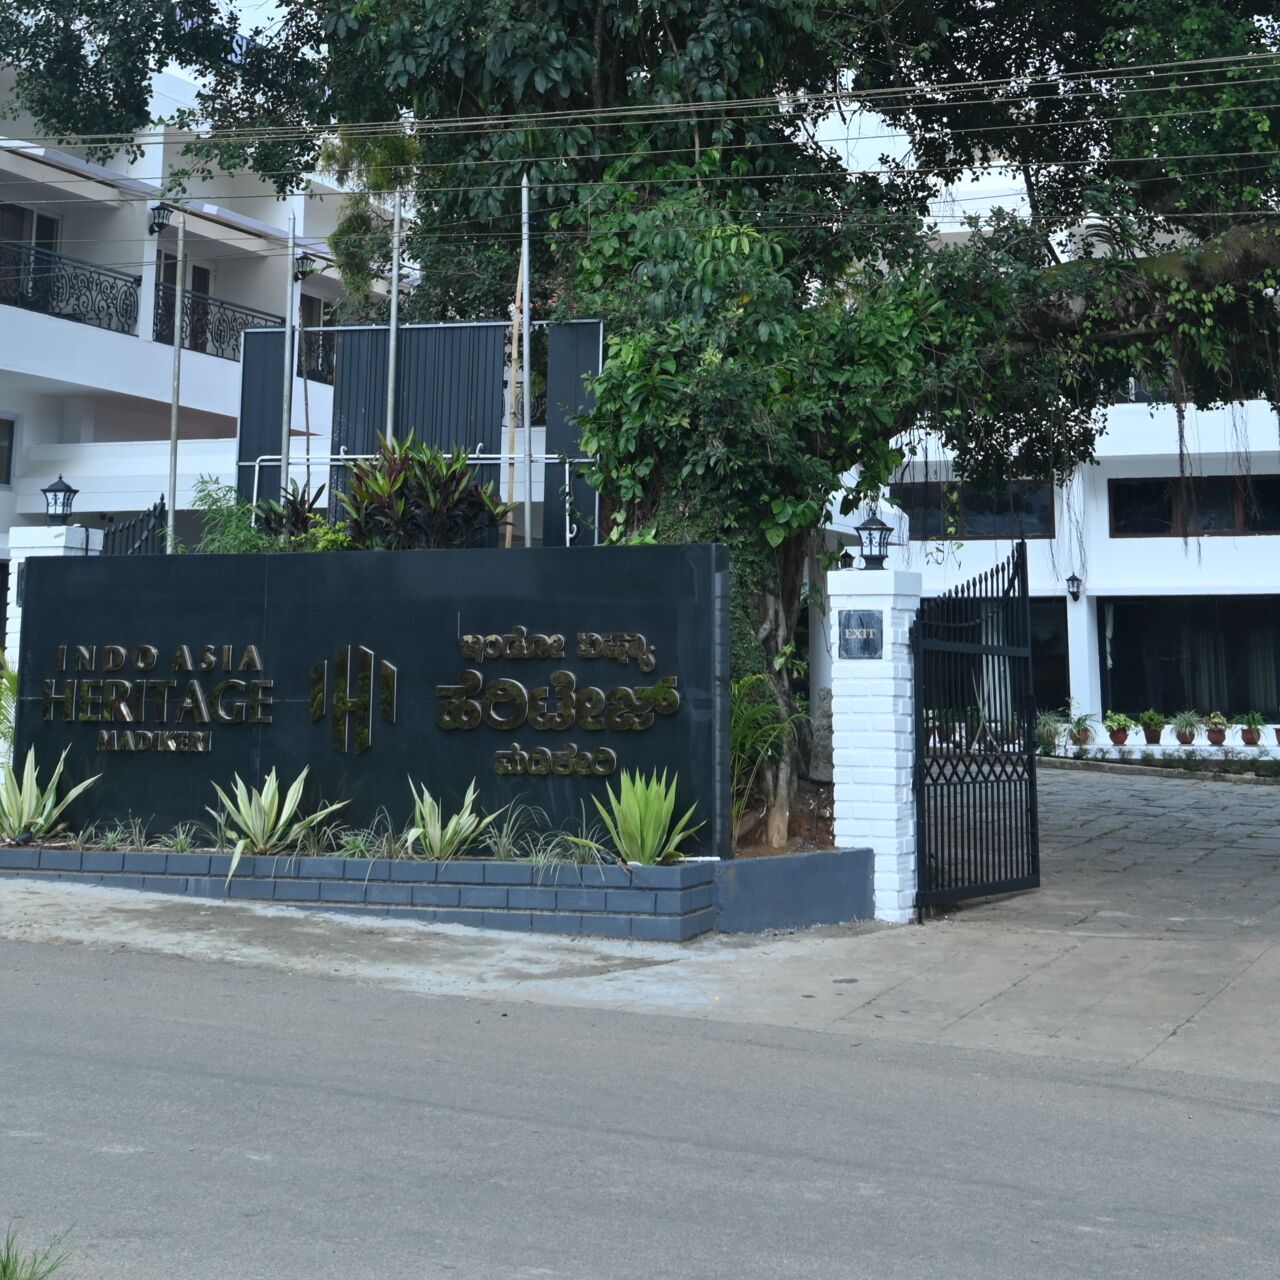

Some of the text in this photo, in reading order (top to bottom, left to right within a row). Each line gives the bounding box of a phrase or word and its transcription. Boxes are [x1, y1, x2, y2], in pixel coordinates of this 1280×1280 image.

[460, 625, 566, 663] ಇಂಡೋ
[844, 628, 876, 639] EXIT
[55, 644, 263, 672] INDO ASIA
[41, 678, 274, 724] HERITAGE
[435, 669, 681, 731] ಹೆರಿಟೇಜ್
[96, 729, 213, 752] MADIKERI
[494, 742, 618, 776] ಮಡಿಕೇರಿ
